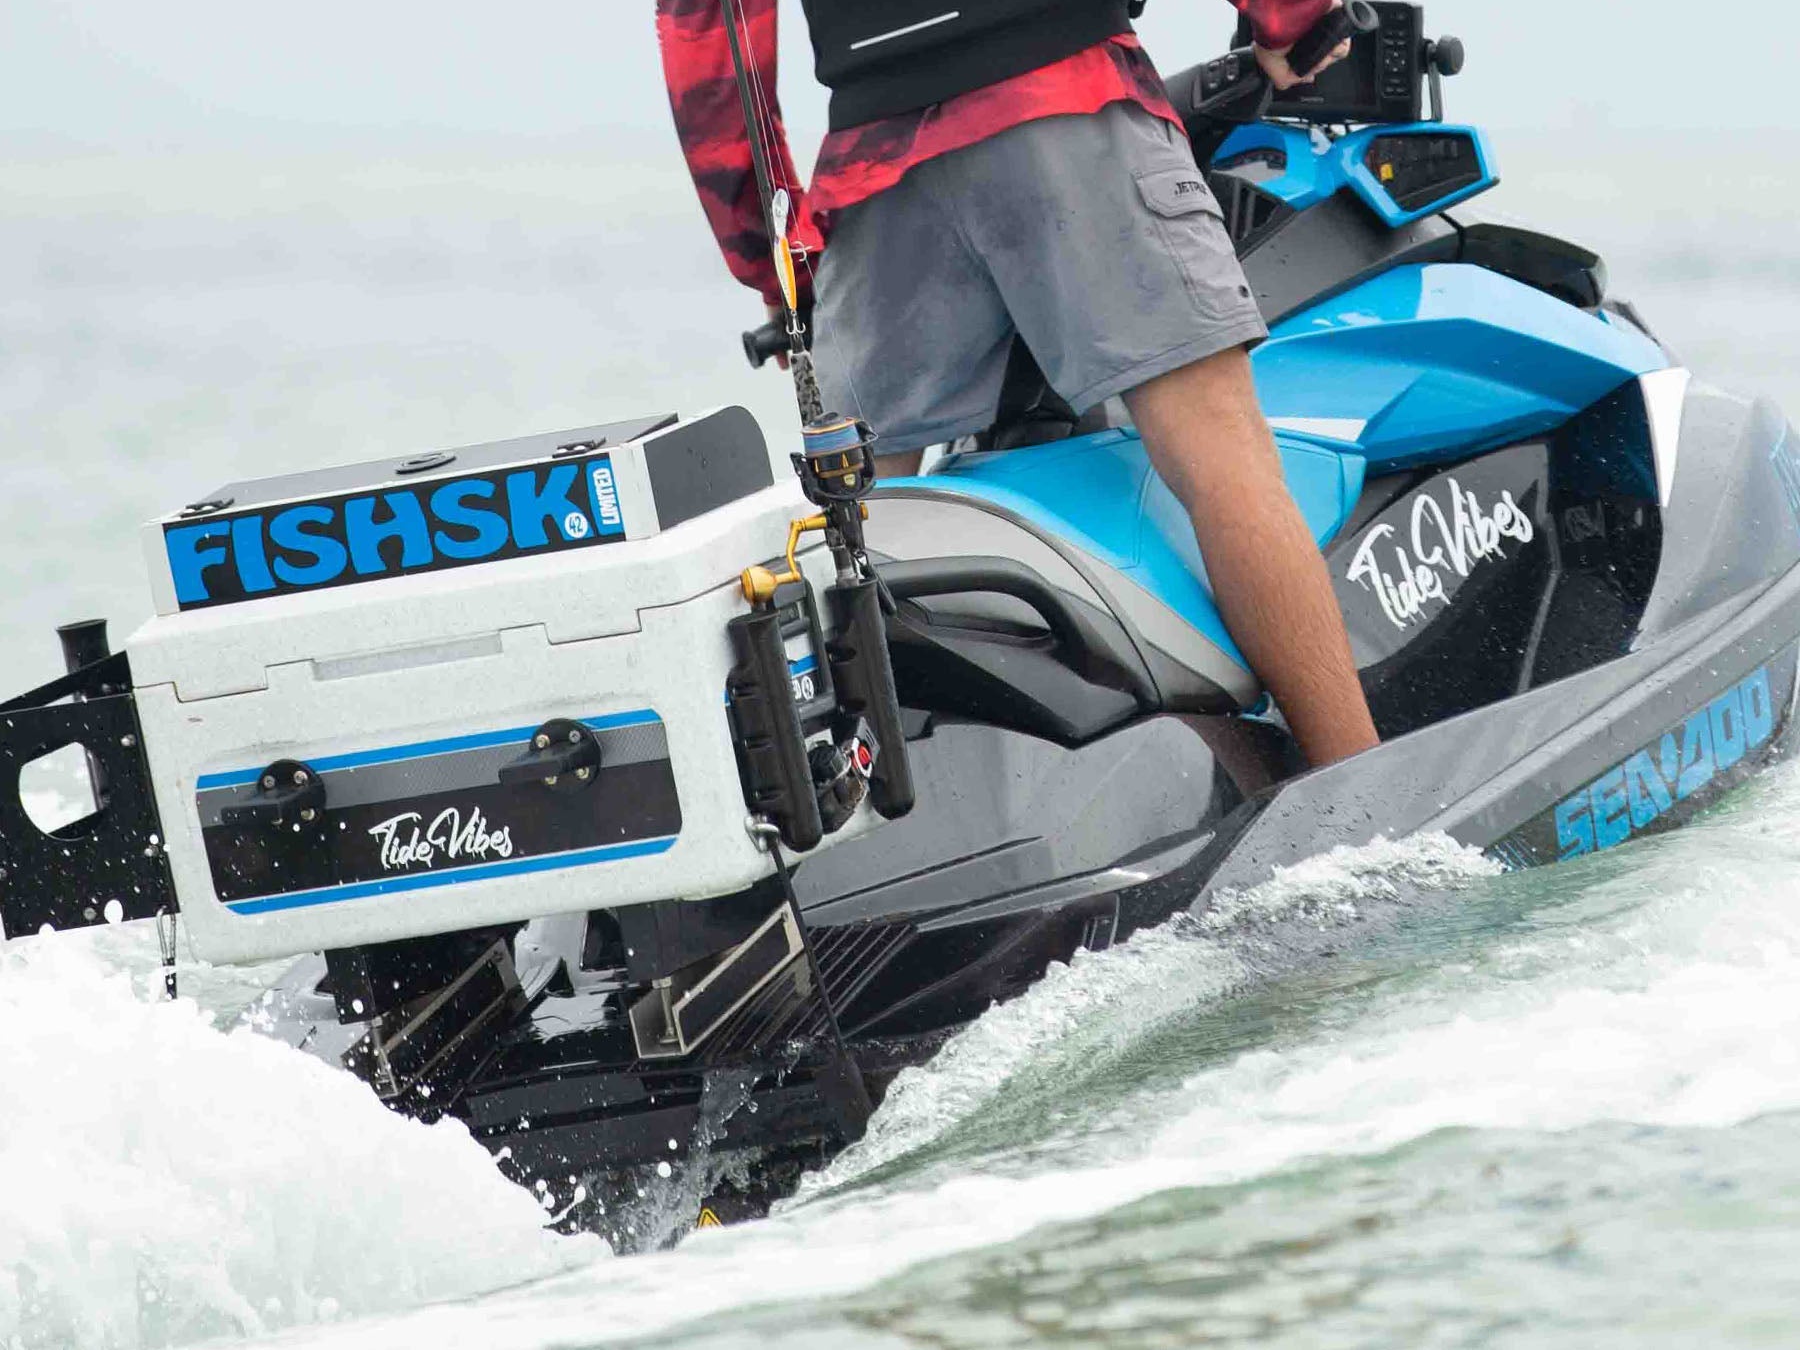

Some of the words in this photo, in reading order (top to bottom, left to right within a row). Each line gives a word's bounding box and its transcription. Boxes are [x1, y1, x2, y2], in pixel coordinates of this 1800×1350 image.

[592, 467, 621, 525] LIMITED
[1346, 523, 1452, 631] Tide
[1411, 478, 1534, 578] Vibes
[368, 811, 434, 871] Tide
[426, 806, 513, 862] Vibes
